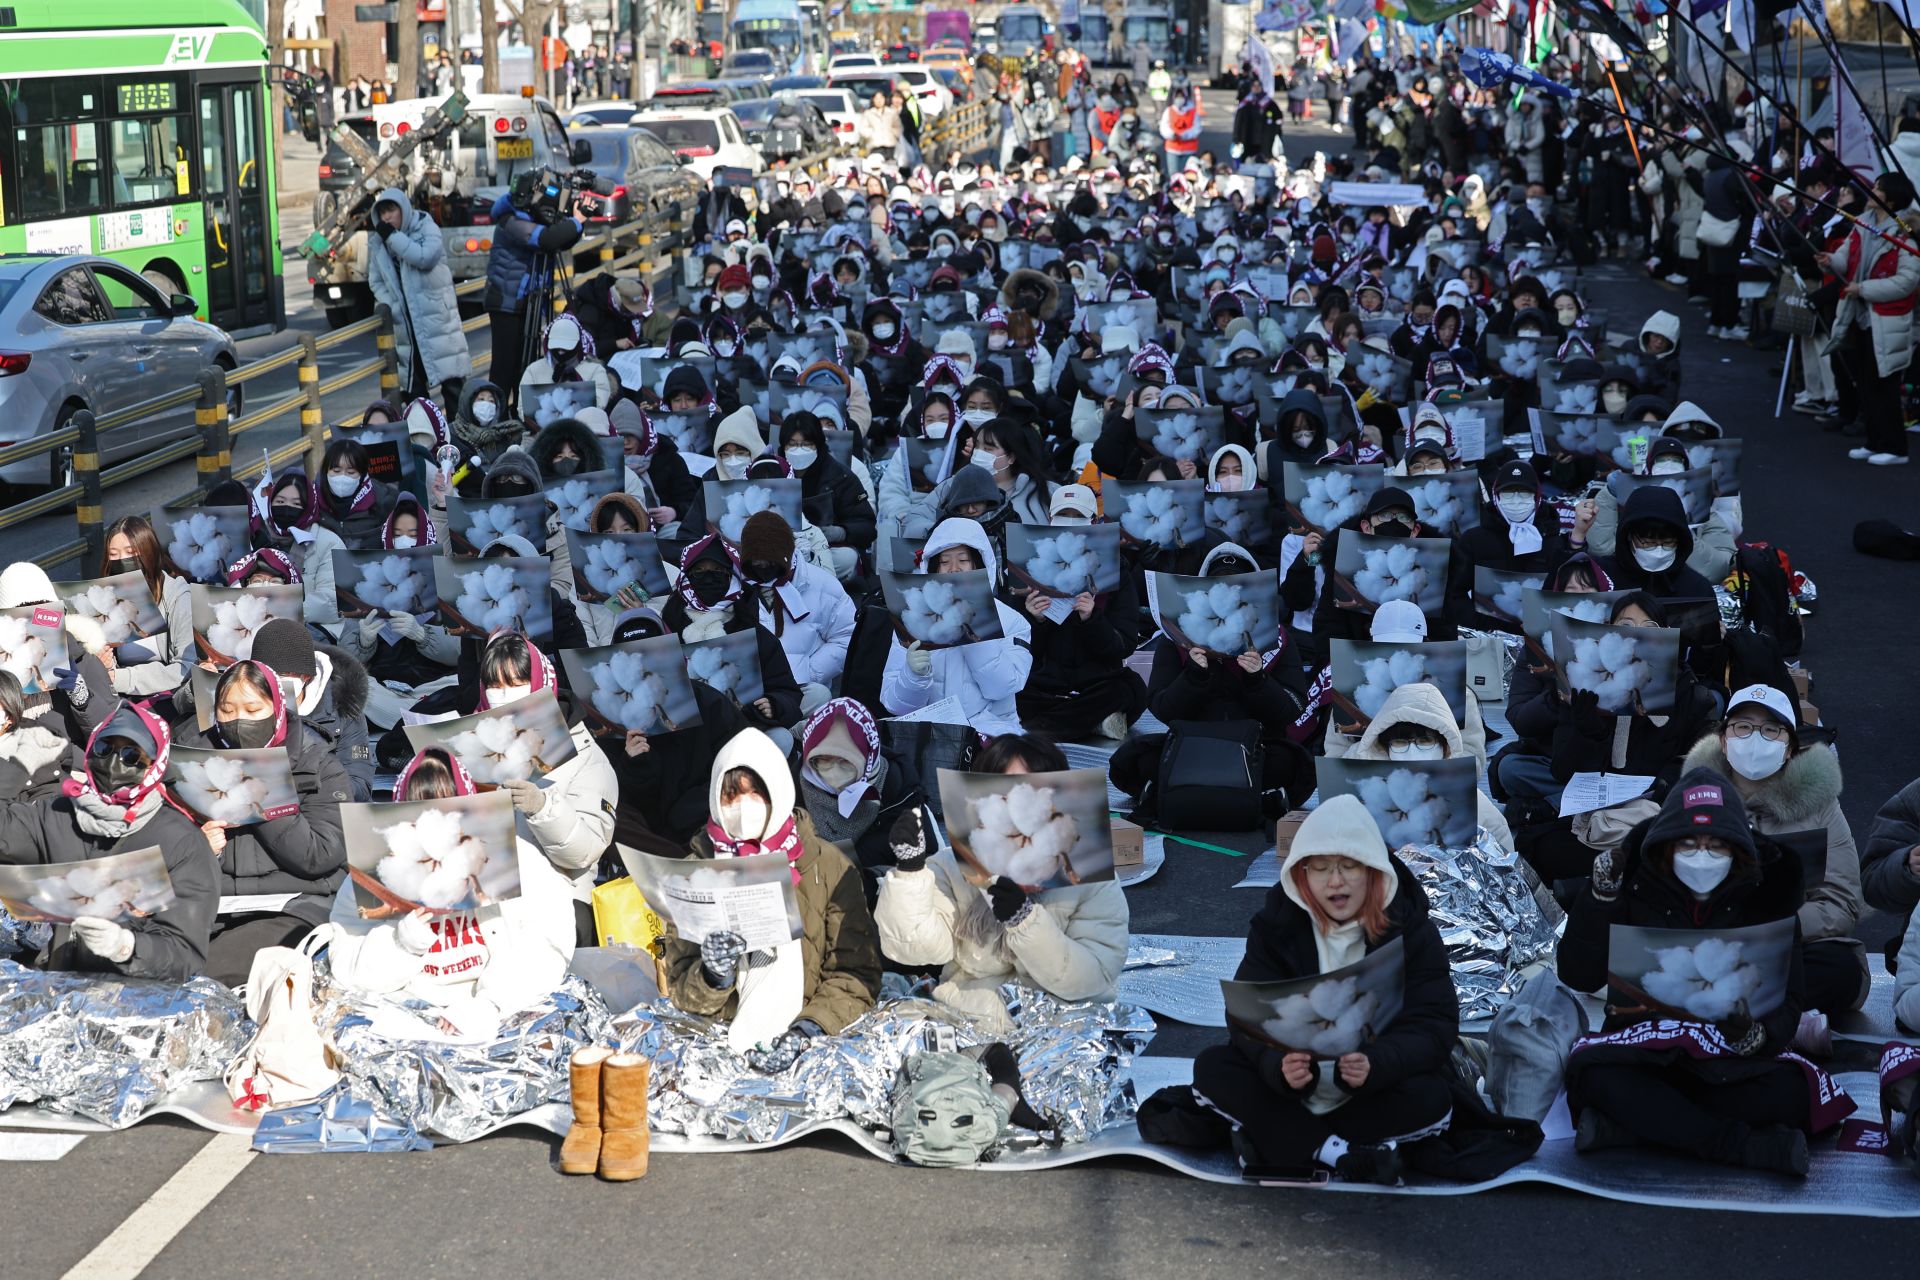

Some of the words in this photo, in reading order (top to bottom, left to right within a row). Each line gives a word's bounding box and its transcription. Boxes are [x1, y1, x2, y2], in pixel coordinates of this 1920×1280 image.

[173, 36, 206, 63] EV
[121, 83, 170, 111] 7025
[623, 628, 646, 638] Supreme
